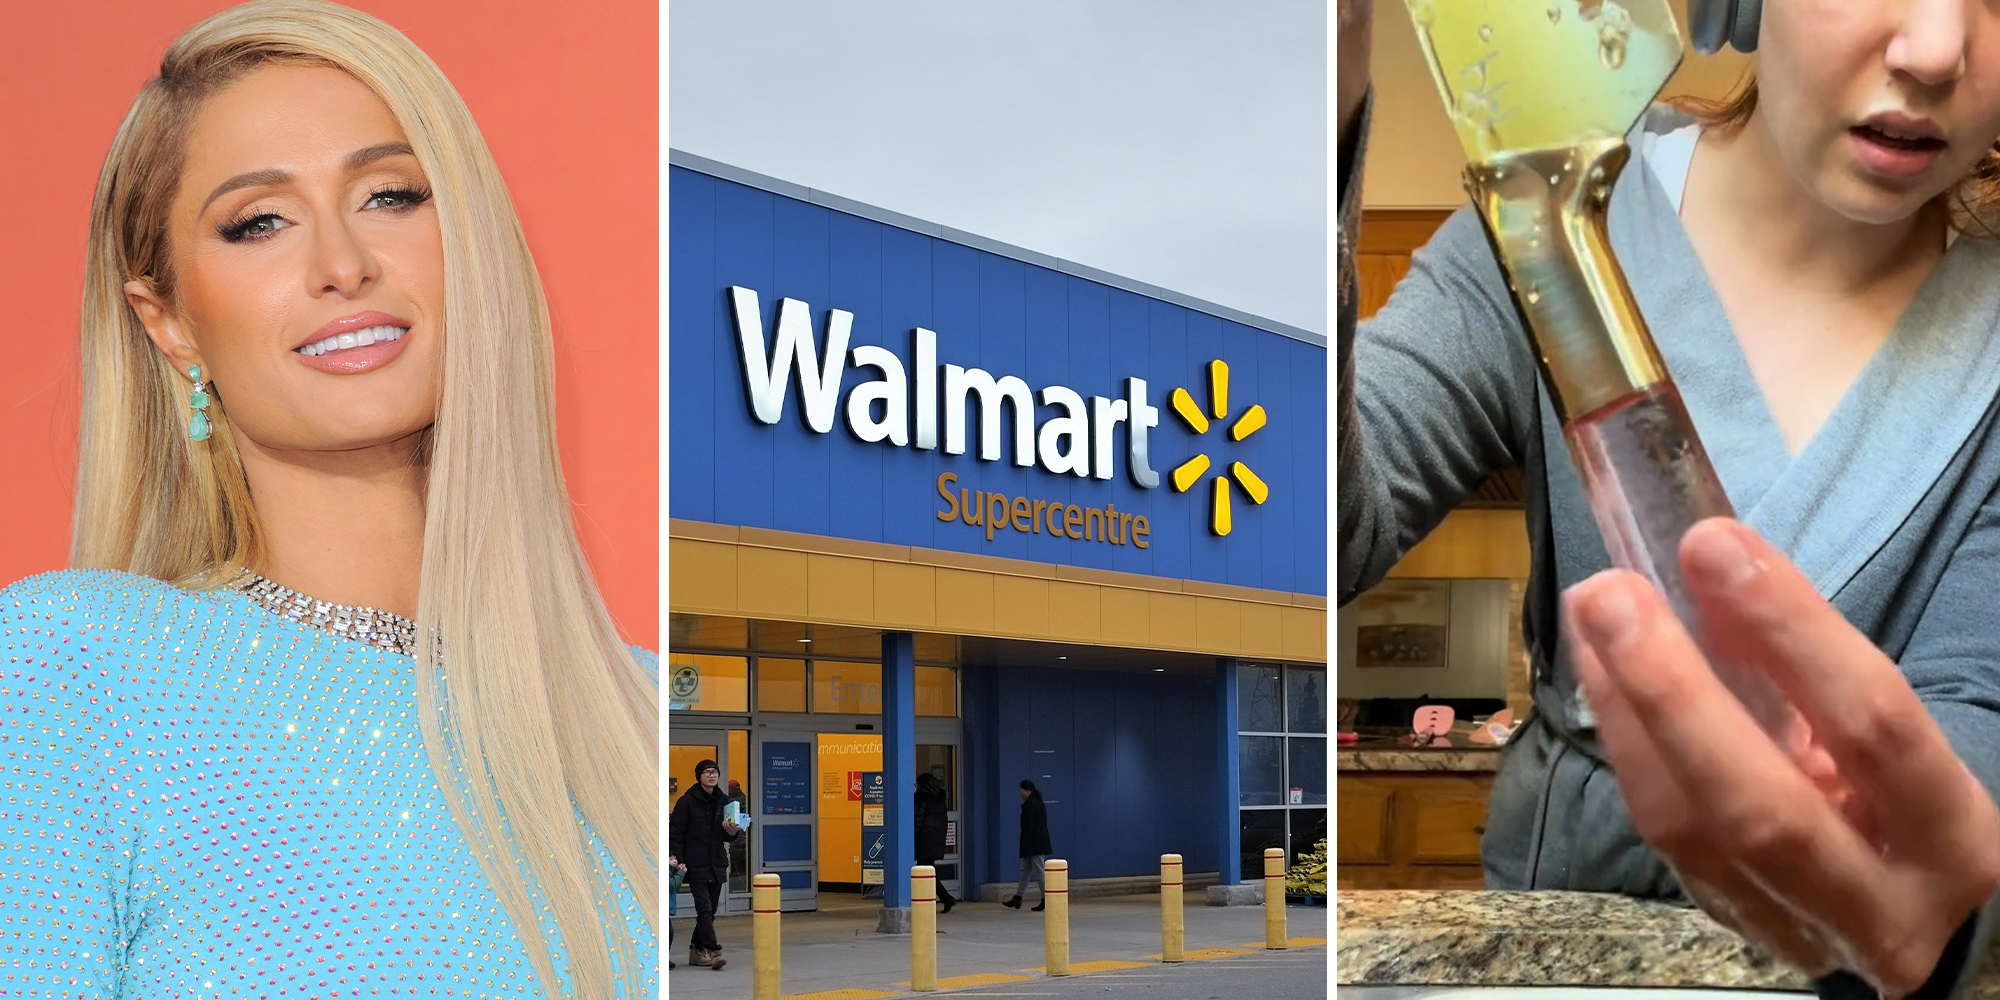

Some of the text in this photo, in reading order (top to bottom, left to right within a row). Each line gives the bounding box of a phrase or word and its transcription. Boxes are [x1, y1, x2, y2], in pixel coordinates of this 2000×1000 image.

[727, 285, 1160, 489] Walmart
[936, 471, 1151, 549] Supercentre
[831, 675, 882, 704] Ente
[818, 740, 883, 755] mmunicatio
